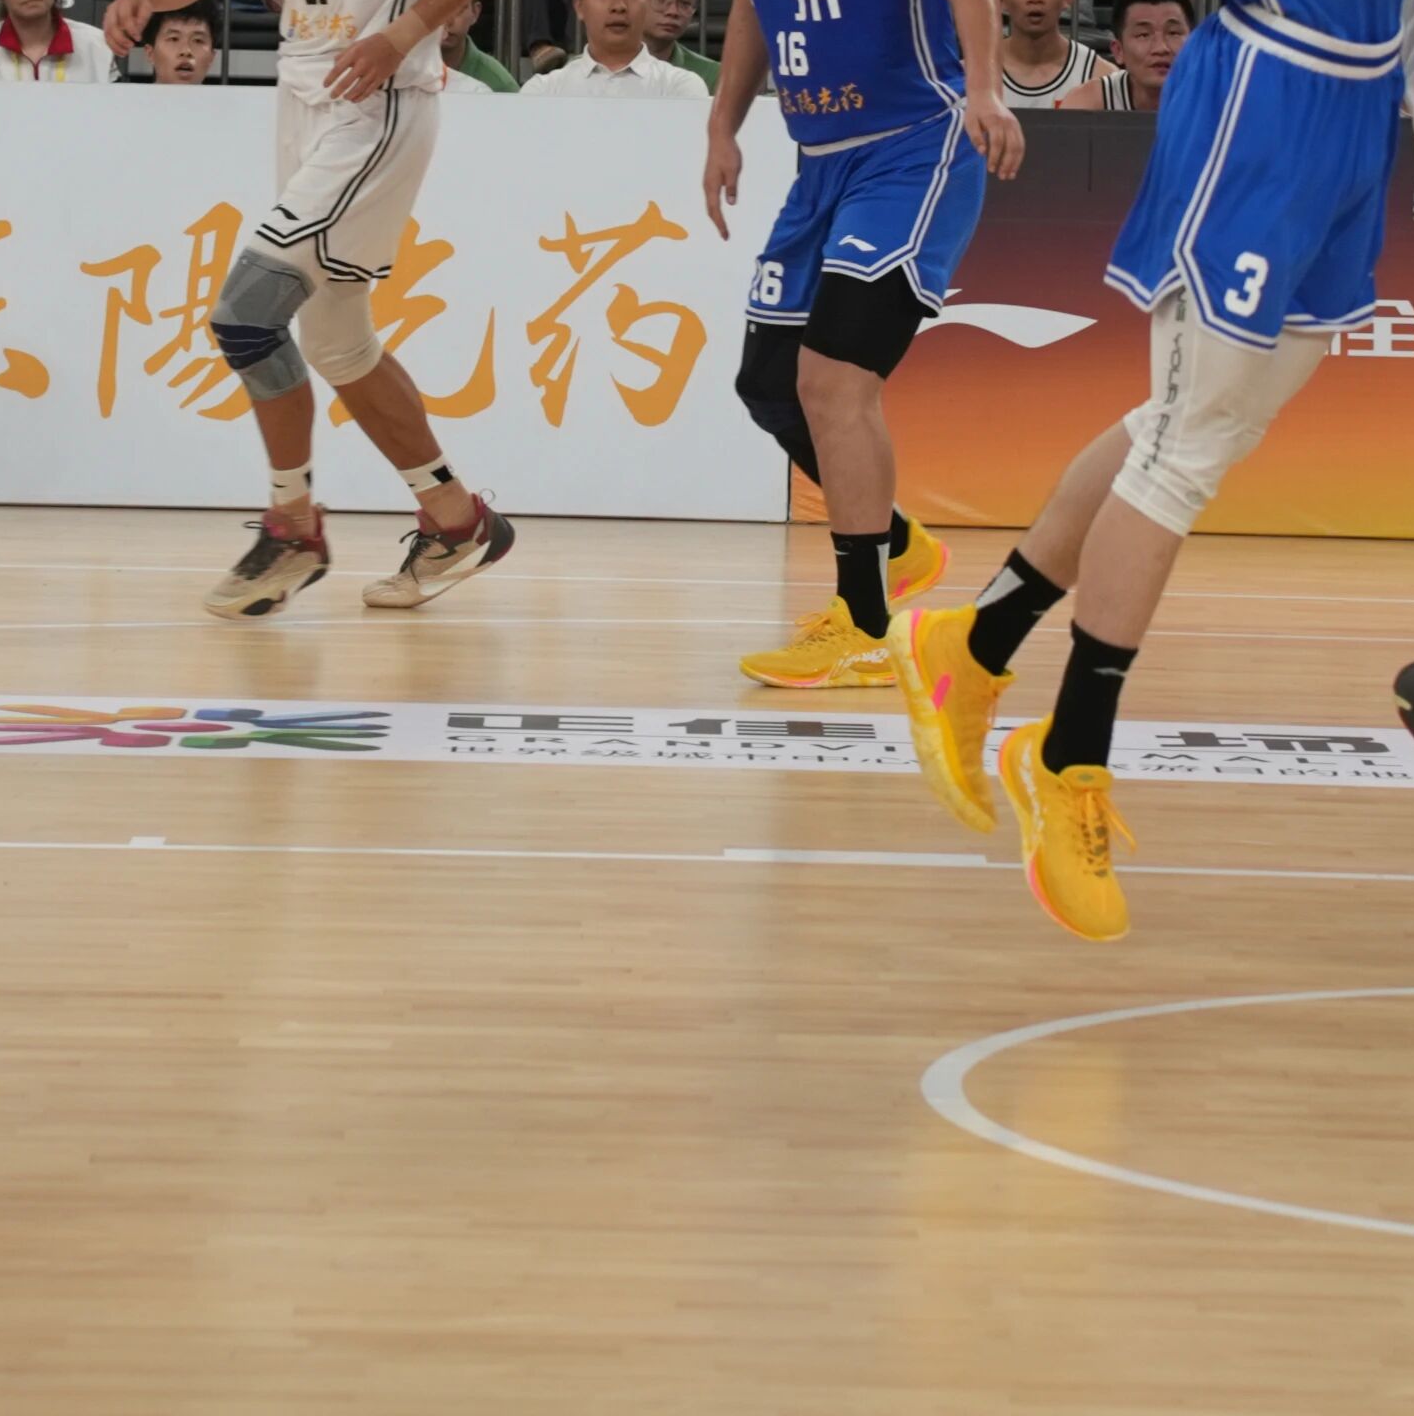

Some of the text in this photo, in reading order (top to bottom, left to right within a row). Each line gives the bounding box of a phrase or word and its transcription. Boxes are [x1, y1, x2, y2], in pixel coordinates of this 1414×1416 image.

[776, 30, 810, 77] 16
[1222, 250, 1269, 317] 3
[1140, 752, 1405, 768] MALL
